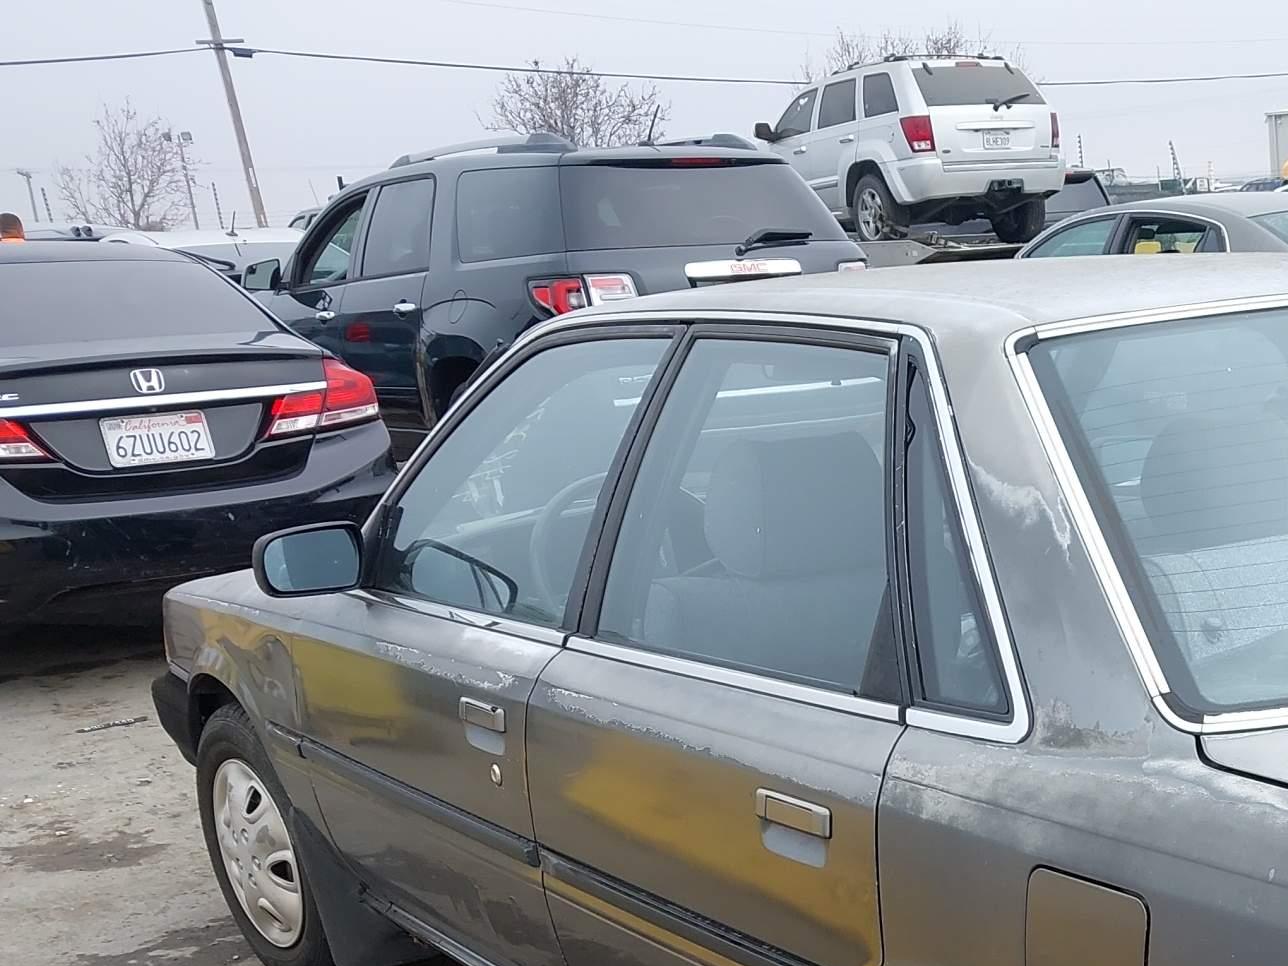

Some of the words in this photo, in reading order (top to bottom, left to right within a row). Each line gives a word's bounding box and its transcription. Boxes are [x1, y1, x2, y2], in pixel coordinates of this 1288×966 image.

[729, 262, 768, 274] GMC
[114, 417, 174, 433] California
[115, 429, 206, 459] 6ZUU602
